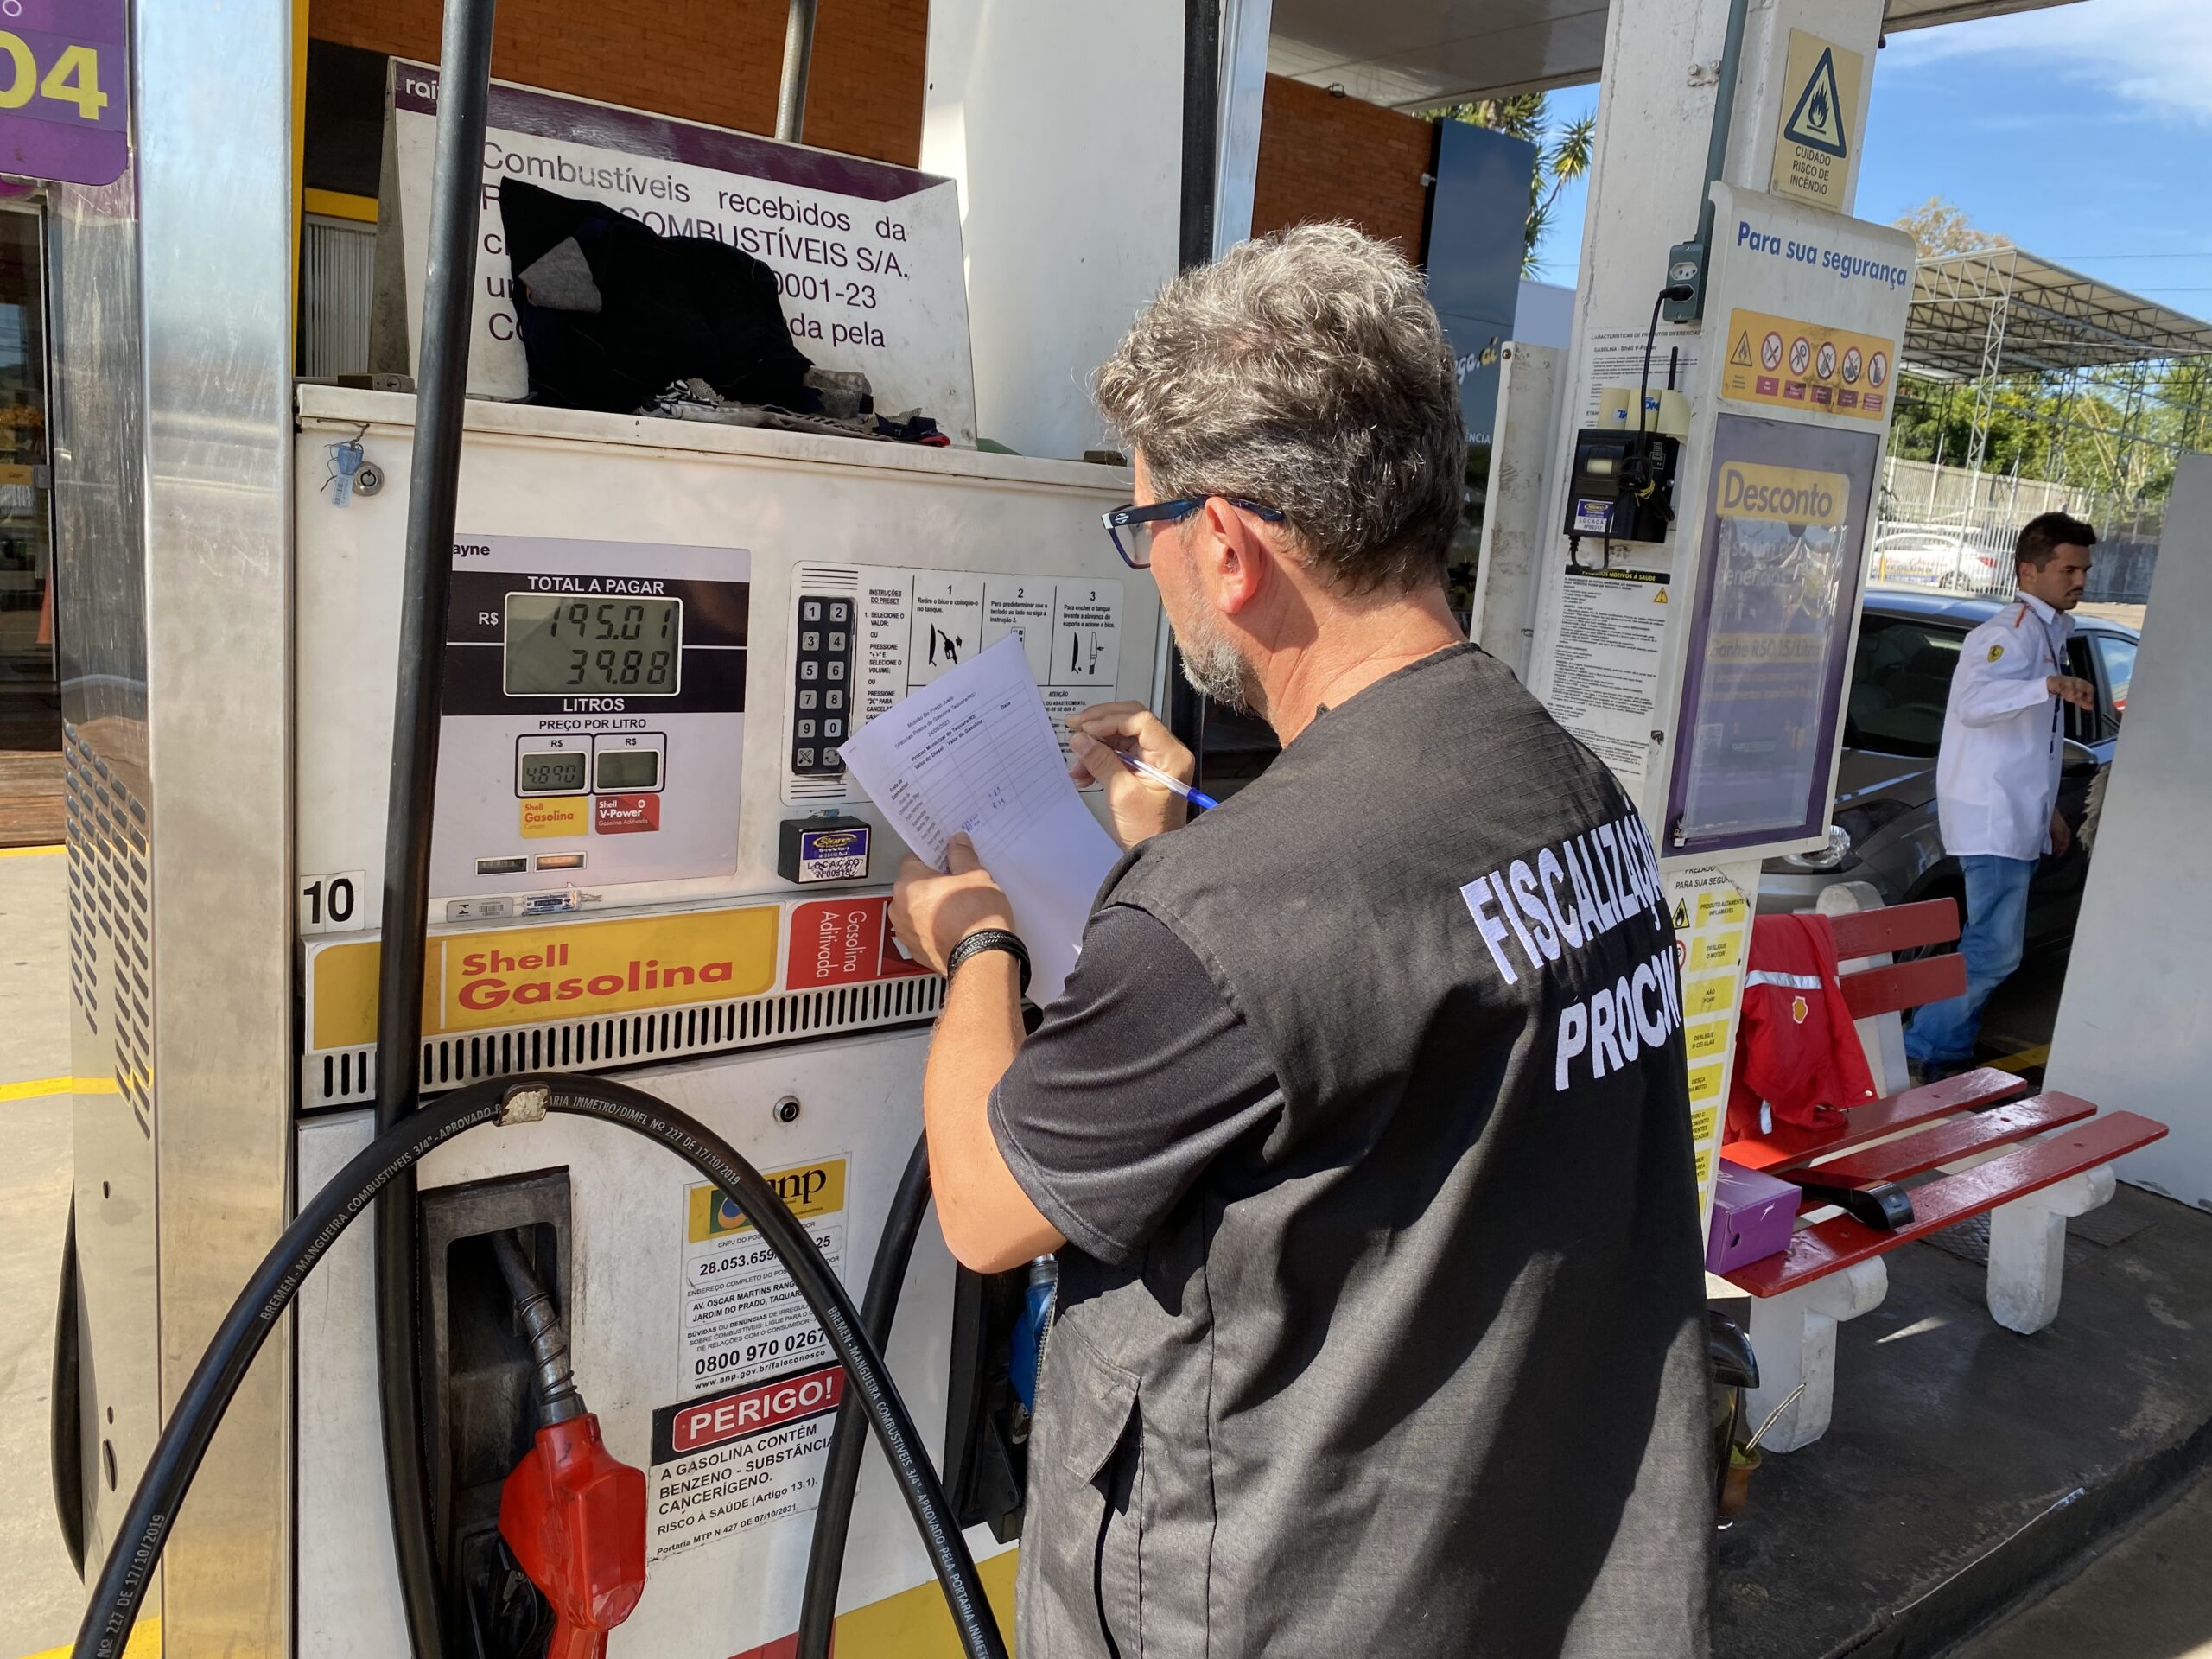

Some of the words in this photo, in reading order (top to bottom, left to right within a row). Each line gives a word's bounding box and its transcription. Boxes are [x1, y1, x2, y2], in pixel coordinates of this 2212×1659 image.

[0, 30, 108, 120] 04
[1796, 146, 1831, 166] CUIDADO
[1792, 159, 1816, 176] RISCO
[1819, 168, 1829, 181] DE
[483, 142, 690, 203] Combustíveis
[718, 190, 851, 232] recebidos
[875, 216, 907, 242] da
[1789, 175, 1827, 194] INCÊNDIO
[619, 207, 849, 268] OMBUSTÍVEIS
[856, 246, 910, 278] S/A.
[1737, 221, 1782, 256] Para
[1786, 240, 1817, 264] sua
[1821, 249, 1908, 290] segurança
[832, 321, 886, 348] pela
[1724, 468, 1833, 518] Desconto
[452, 543, 491, 556] ayne
[527, 575, 584, 593] TOTAL
[588, 578, 601, 594] A
[607, 580, 664, 594] PAGAR
[1018, 588, 1024, 598] 2
[1090, 591, 1096, 601] 3
[478, 612, 499, 626] R$
[550, 603, 671, 640] 195.01
[810, 607, 815, 617] 1
[836, 607, 842, 618] 2
[808, 636, 814, 646] 3
[834, 636, 840, 646] 4
[567, 650, 670, 684] 39.88
[806, 665, 813, 676] 5
[832, 665, 839, 676] 6
[563, 697, 625, 712] LITROS
[805, 695, 811, 705] 7
[831, 694, 837, 705] 8
[539, 720, 582, 731] PREÇO
[585, 719, 609, 729] POR
[613, 718, 647, 729] LITRO
[804, 723, 810, 734] 9
[830, 723, 836, 734] 0
[550, 739, 563, 747] R$
[625, 738, 637, 747] R$
[524, 803, 544, 811] Shell
[524, 810, 575, 823] Gasolina
[599, 800, 617, 809] Shell
[600, 809, 643, 819] V-Power
[1675, 879, 1693, 889] PARA
[1694, 878, 1707, 887] SUA
[302, 877, 355, 924] 10
[816, 910, 840, 979] Aditivada
[843, 910, 867, 973] Gasolina
[461, 943, 569, 976] Shell
[458, 958, 734, 1011] Gasolina
[1696, 1039, 1715, 1047] CELULAR
[572, 1098, 650, 1125] INMETRO/DIMEL
[665, 1126, 683, 1141] 227
[683, 1137, 695, 1149] DE
[695, 1145, 741, 1185] 17/10/2019
[259, 1274, 297, 1322] BREMEN
[294, 1211, 349, 1276] MANGUEIRA
[346, 1153, 413, 1214] COMBUSTIVEIS
[439, 1106, 493, 1142] APROVADO
[718, 1237, 735, 1249] CNPJ
[736, 1236, 747, 1244] DO
[687, 1282, 725, 1297] ENDEREÇO
[726, 1274, 762, 1288] COMPLETO
[763, 1271, 773, 1280] DO
[693, 1300, 705, 1311] AV.
[707, 1293, 736, 1308] OSCAR
[737, 1285, 772, 1300] MARTINS
[687, 1324, 717, 1338] DÚVIDAS
[729, 1312, 767, 1328] DENÚNCIAS
[692, 1306, 723, 1322] JARDIM
[724, 1305, 737, 1316] DO
[690, 1335, 713, 1345] SOBRE
[765, 1317, 784, 1328] LIGUE
[785, 1313, 802, 1323] PARA
[708, 1336, 743, 1351] RELAÇÕES
[744, 1331, 759, 1341] COM
[766, 1318, 810, 1335] CONSUMIDOR
[695, 1350, 741, 1375] 0800
[746, 1339, 779, 1362] 970
[785, 1328, 826, 1351] 0267
[695, 1349, 826, 1389] www.anp.gov.br/faleconosco
[690, 1376, 833, 1440] PERIGO!
[660, 1467, 672, 1481] A
[676, 1444, 753, 1477] GASOLINA
[757, 1422, 817, 1452] CONTÉM
[659, 1468, 732, 1500] BENZENO
[746, 1435, 834, 1473] SUBSTÂNCIA
[827, 1306, 851, 1346] BREMEN
[849, 1344, 881, 1403] MANGUEIRA
[875, 1401, 912, 1469] COMBUSTIVEIS
[917, 1493, 946, 1546] APROVADO
[939, 1546, 957, 1572] PELA
[950, 1573, 976, 1623] PORTARIA
[658, 1471, 772, 1515] CANCERÍGENO.
[657, 1515, 695, 1535] RISCO
[698, 1510, 707, 1522] À
[709, 1498, 749, 1518] SAÚDE
[752, 1485, 788, 1507] (Artigo
[791, 1476, 818, 1491] 13.1).
[657, 1538, 691, 1555] Portaria
[693, 1531, 712, 1543] MTP
[722, 1523, 738, 1534] 427
[741, 1518, 753, 1528] DE
[754, 1503, 797, 1522] 07/10/2021
[106, 1611, 124, 1634] 227
[116, 1591, 134, 1607] DE
[125, 1514, 165, 1586] 17/10/2019
